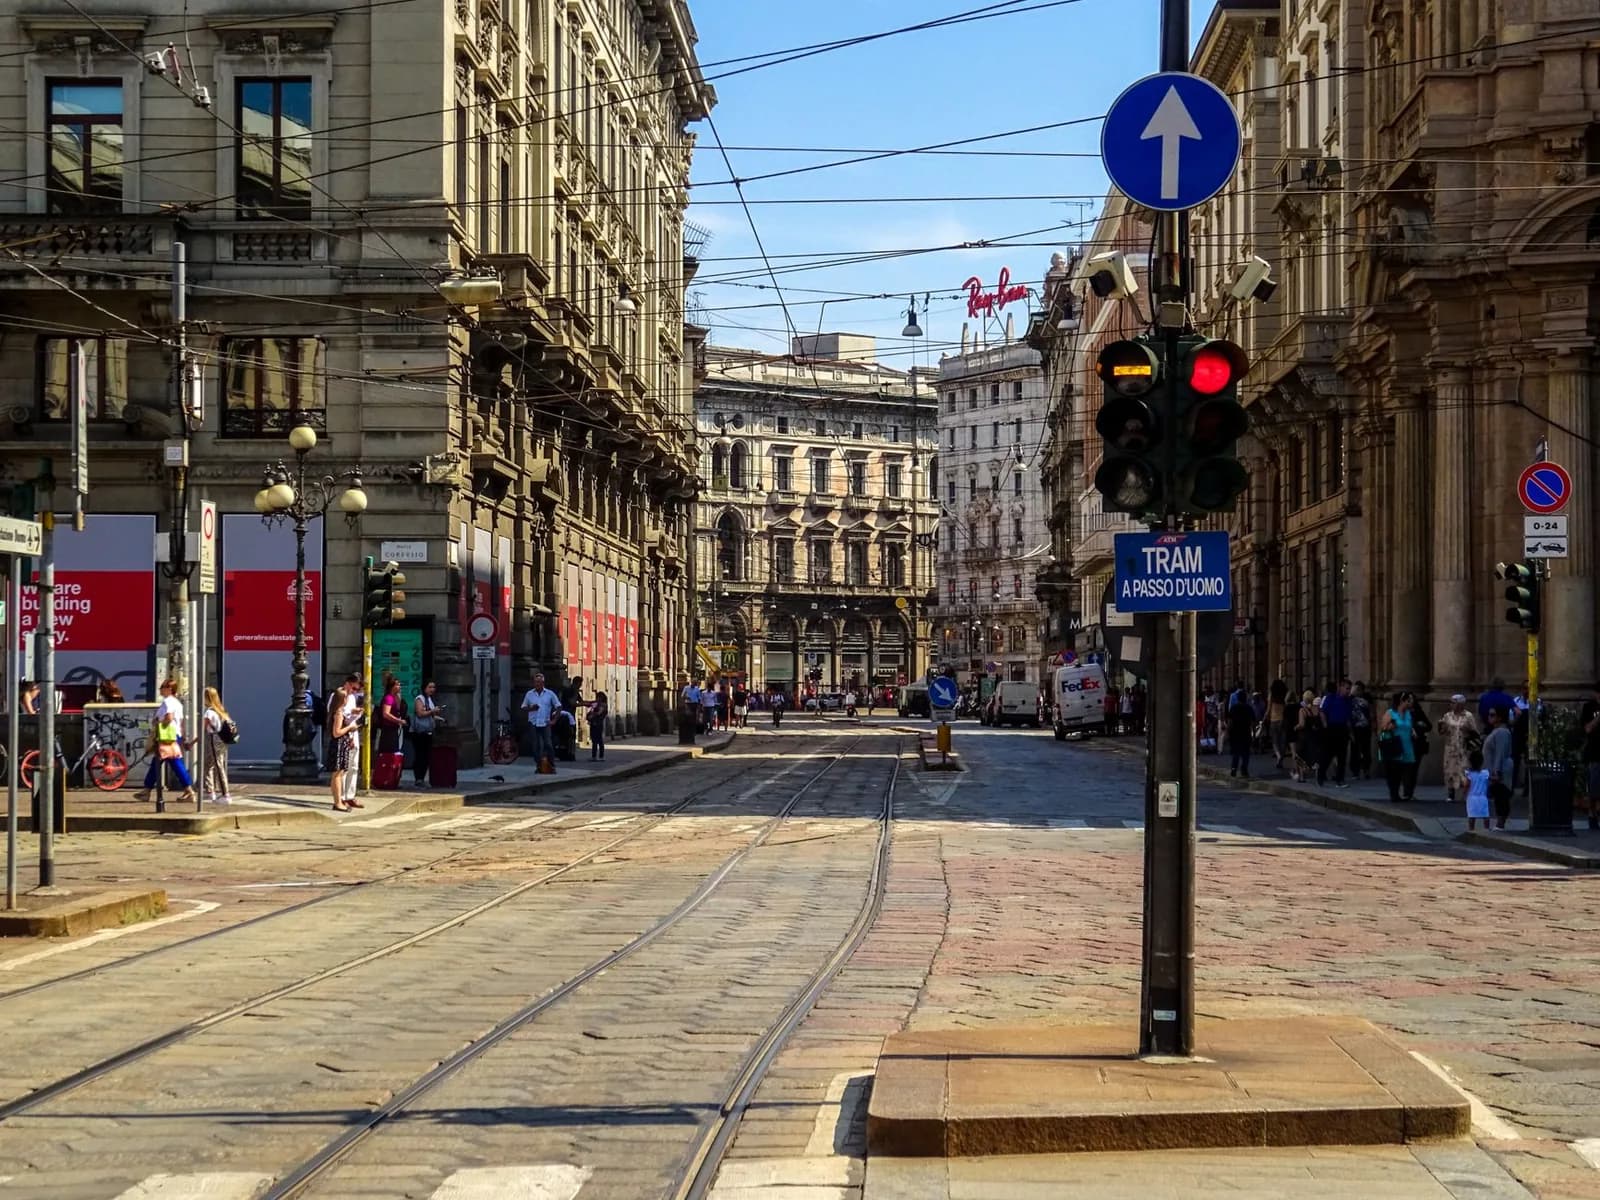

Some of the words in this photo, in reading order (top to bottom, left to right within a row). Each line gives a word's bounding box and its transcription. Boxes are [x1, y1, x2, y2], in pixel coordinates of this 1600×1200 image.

[1533, 522, 1558, 530] 0-24
[1141, 546, 1203, 575] TRAM
[53, 583, 82, 595] are
[1122, 580, 1131, 598] A
[1133, 578, 1174, 598] PASSO
[1175, 577, 1224, 597] D'UOMO
[22, 595, 91, 614] buding
[21, 614, 32, 626] a
[1061, 677, 1102, 694] FedEx
